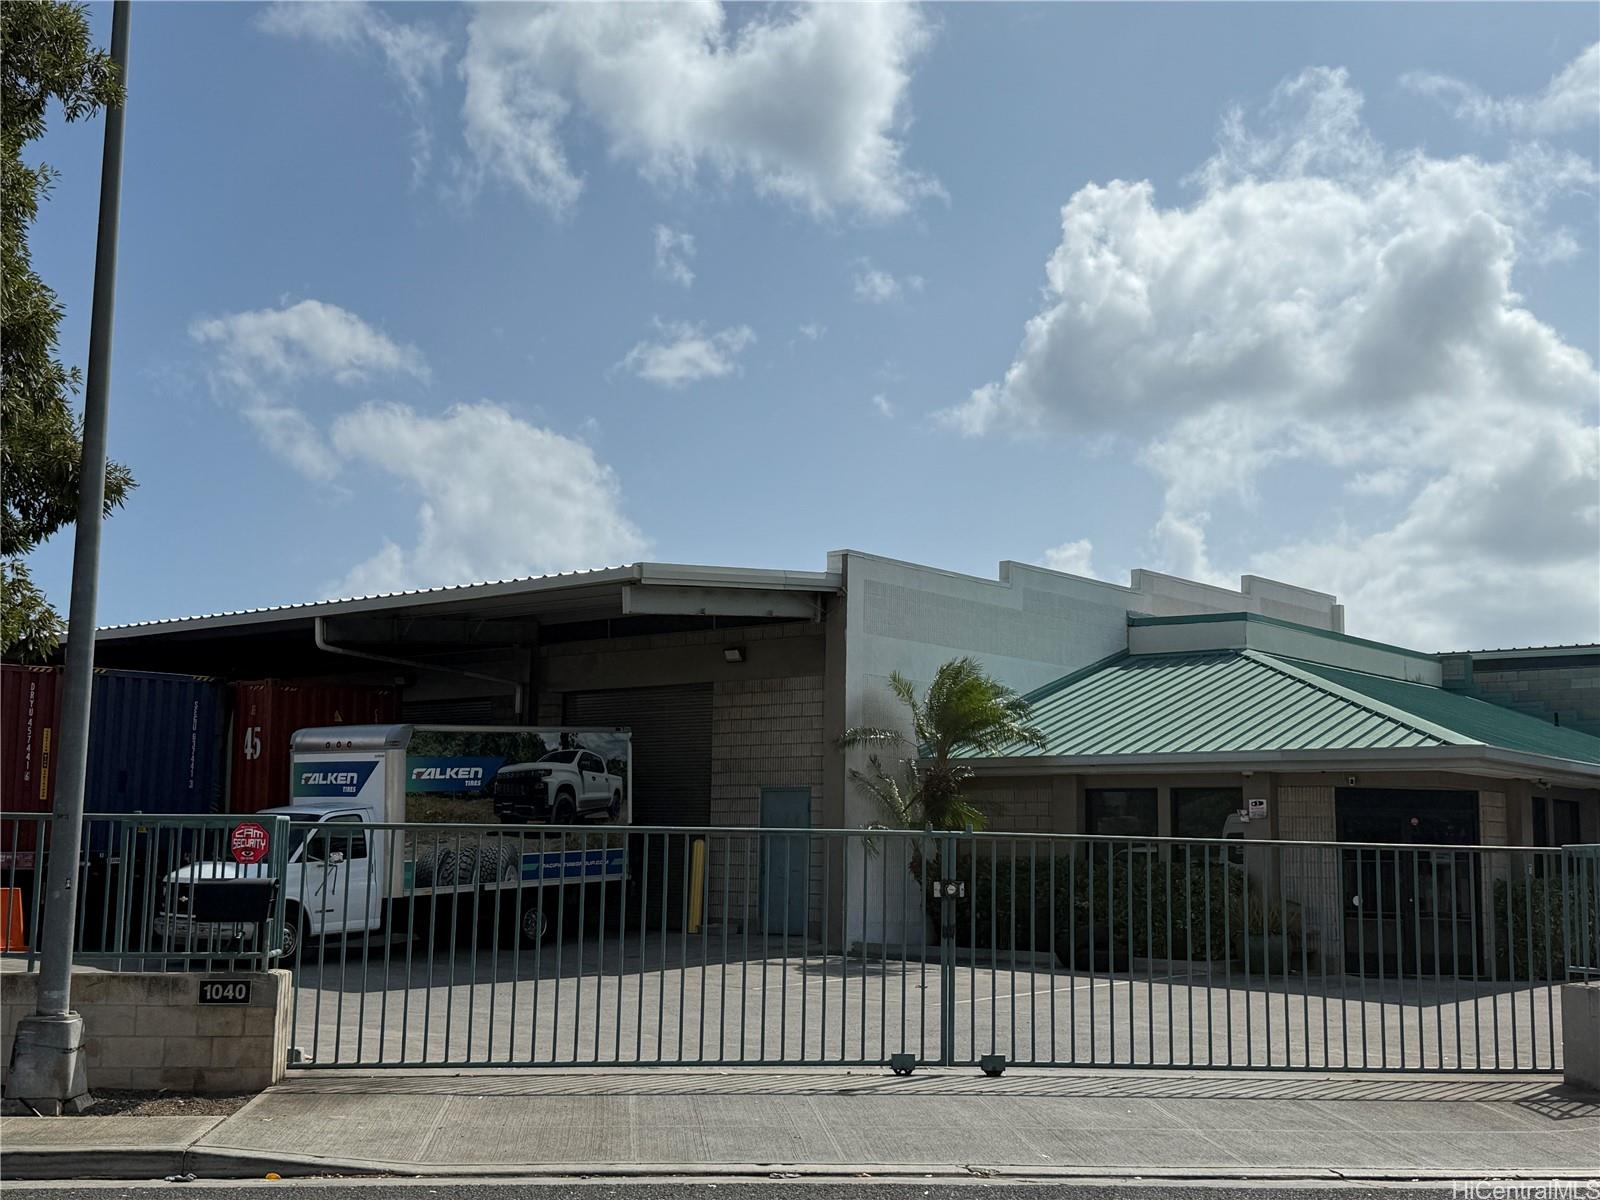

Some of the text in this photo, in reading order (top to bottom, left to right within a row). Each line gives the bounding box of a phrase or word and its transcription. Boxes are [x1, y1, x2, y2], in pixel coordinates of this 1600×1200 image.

[243, 726, 261, 760] 45
[301, 772, 358, 785] FALKEN
[411, 767, 483, 780] FALKEN
[235, 828, 264, 838] CAM
[232, 838, 266, 850] SECURITY
[203, 984, 247, 1000] 1040
